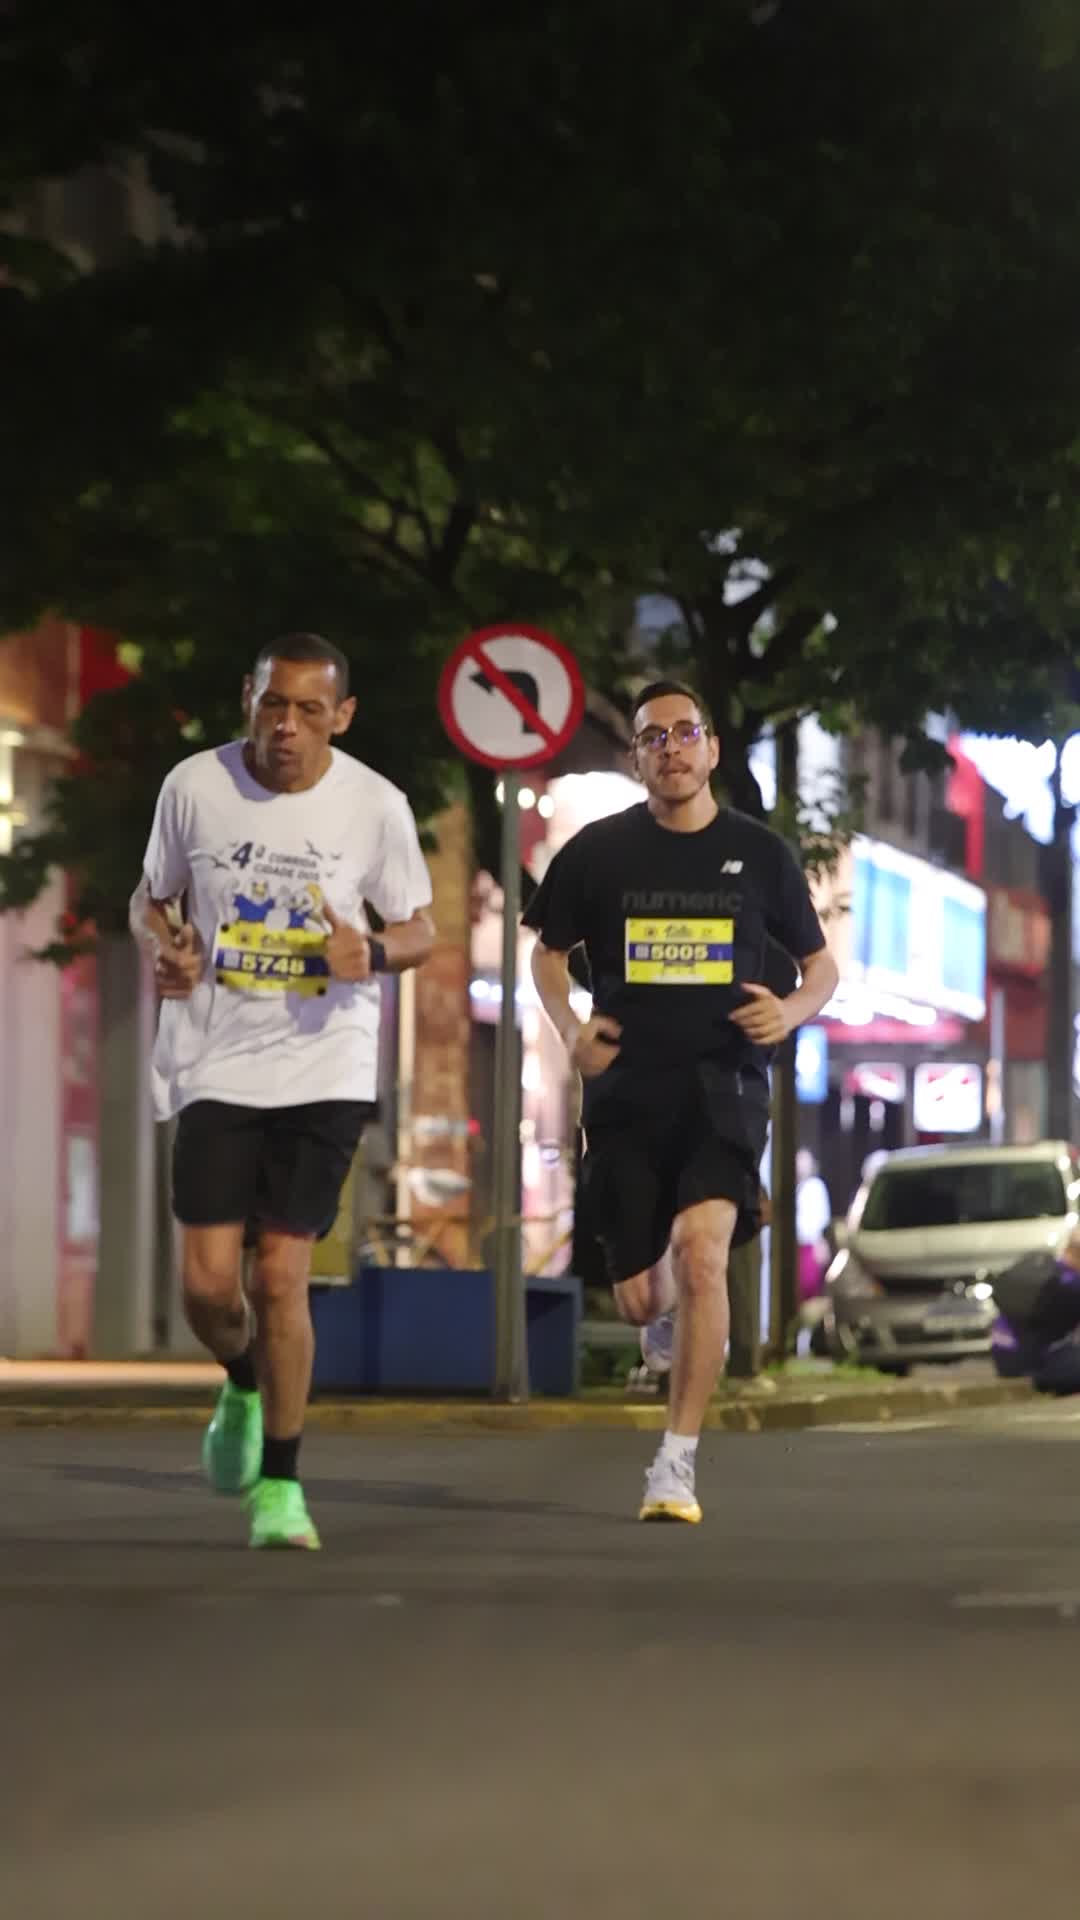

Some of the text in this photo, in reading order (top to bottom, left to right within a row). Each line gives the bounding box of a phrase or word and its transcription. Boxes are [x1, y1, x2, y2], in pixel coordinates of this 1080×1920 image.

[622, 890, 743, 912] numeric
[651, 944, 708, 960] 5005
[242, 956, 305, 975] 5748
